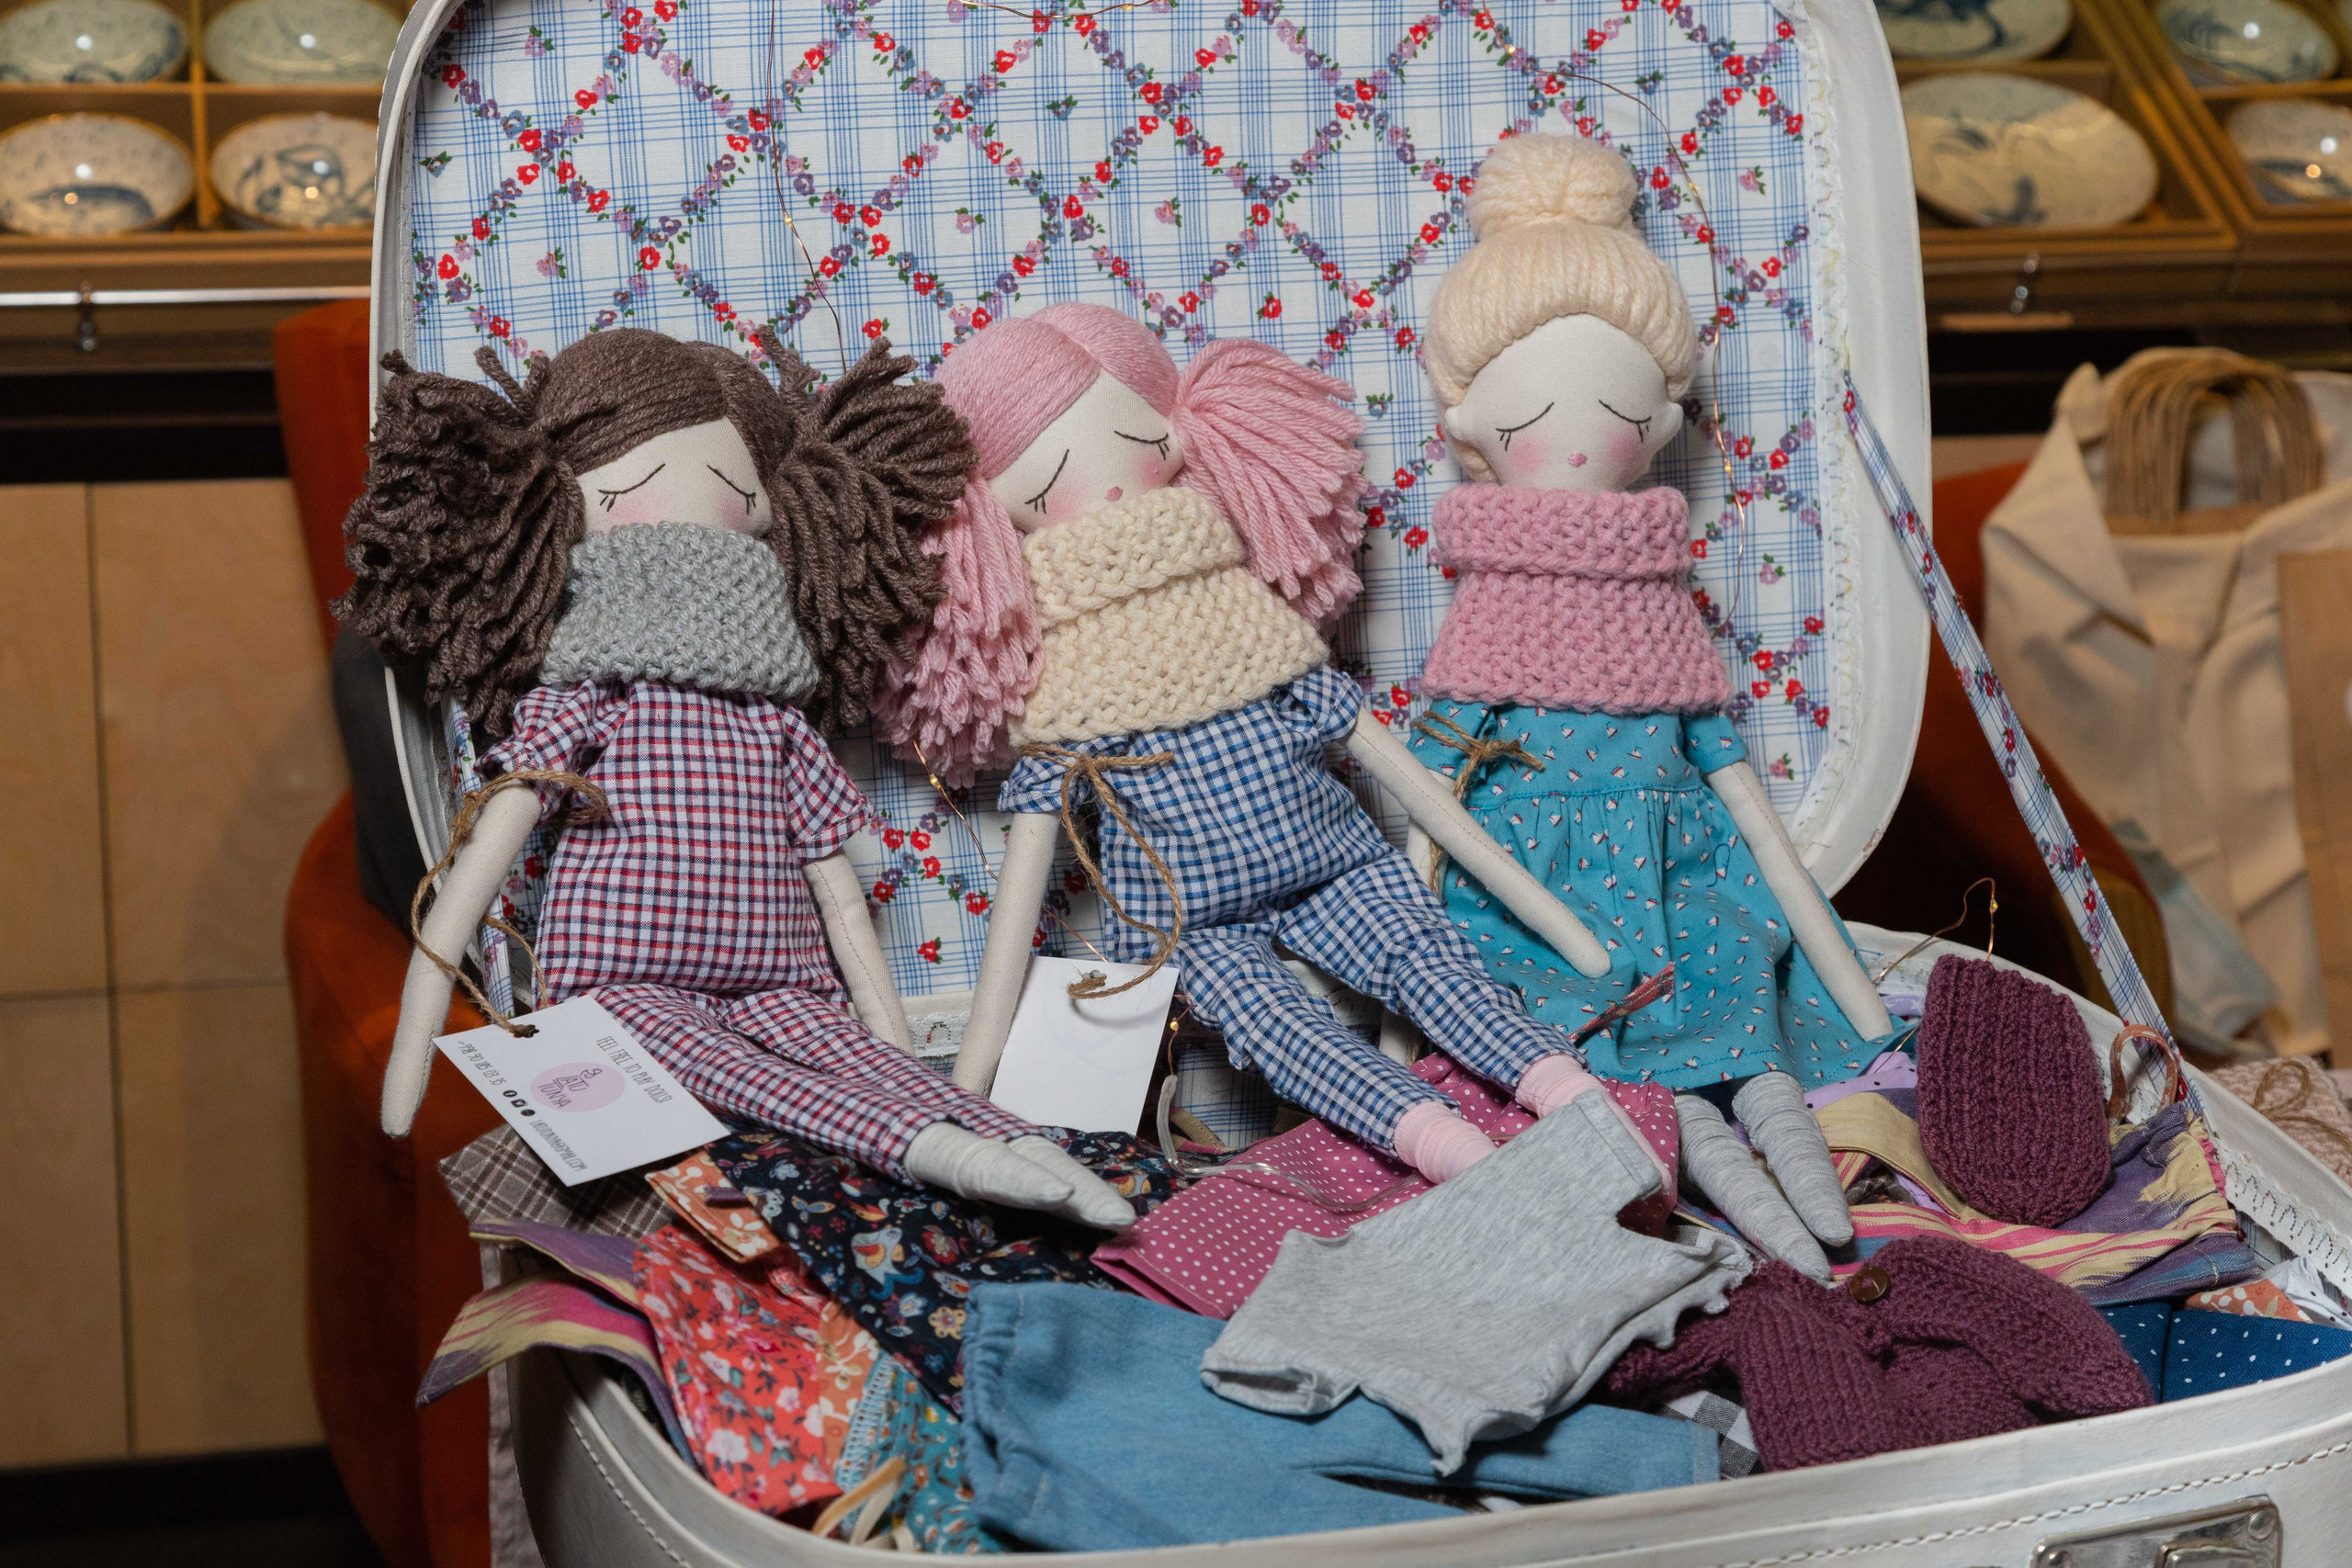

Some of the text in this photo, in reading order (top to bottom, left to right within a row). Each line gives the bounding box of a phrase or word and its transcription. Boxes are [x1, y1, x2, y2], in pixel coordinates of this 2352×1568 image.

[458, 1040, 478, 1055] +998
[595, 1035, 620, 1052] FEEL
[466, 1053, 485, 1063] 90
[607, 1048, 635, 1066] FREE
[481, 1069, 500, 1078] 03
[621, 1062, 643, 1074] TO
[488, 1077, 507, 1086] 35
[630, 1070, 656, 1087] PLAY
[537, 1078, 572, 1110] TUNYA
